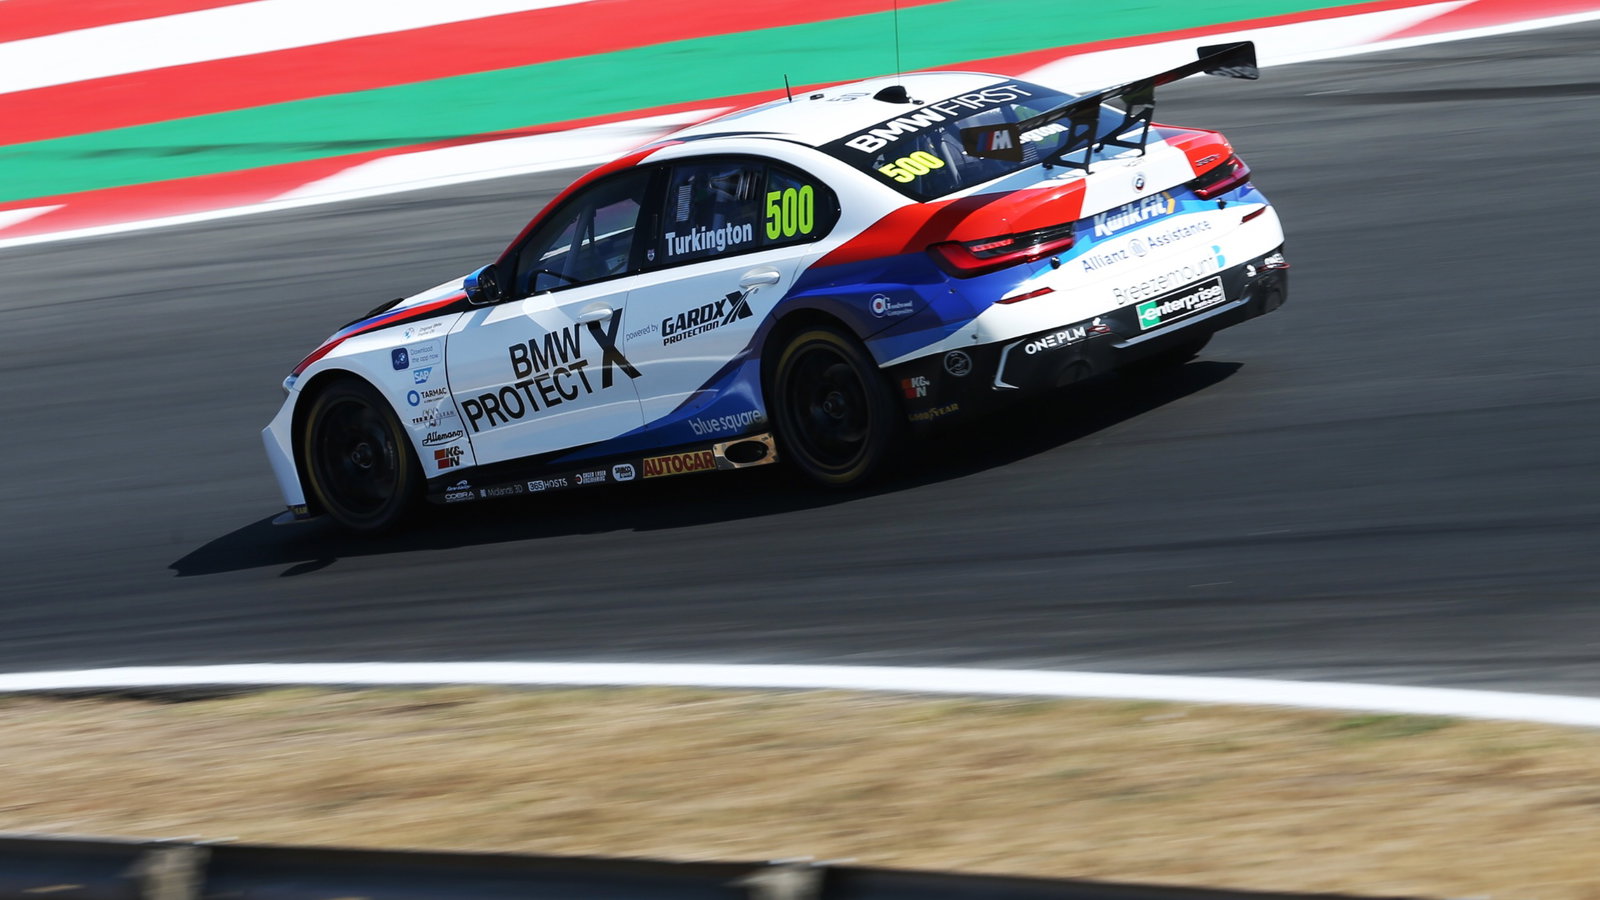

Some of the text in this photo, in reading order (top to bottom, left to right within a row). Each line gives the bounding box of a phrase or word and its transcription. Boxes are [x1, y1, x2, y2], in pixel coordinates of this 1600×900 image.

[878, 150, 945, 183] 500
[765, 184, 814, 240] 500
[665, 222, 752, 256] Turkington
[1081, 220, 1212, 273] Allianz Assistance
[1143, 284, 1222, 321] enterprise
[585, 307, 643, 390] X
[625, 323, 659, 342] powered by
[663, 320, 720, 346] PROTECTION
[1024, 326, 1087, 355] ONE PLM
[508, 322, 582, 379] BMW
[414, 370, 430, 381] SAP
[421, 387, 447, 399] TARMAC
[460, 359, 593, 433] PROTECT
[643, 450, 716, 478] AUTOCAR
